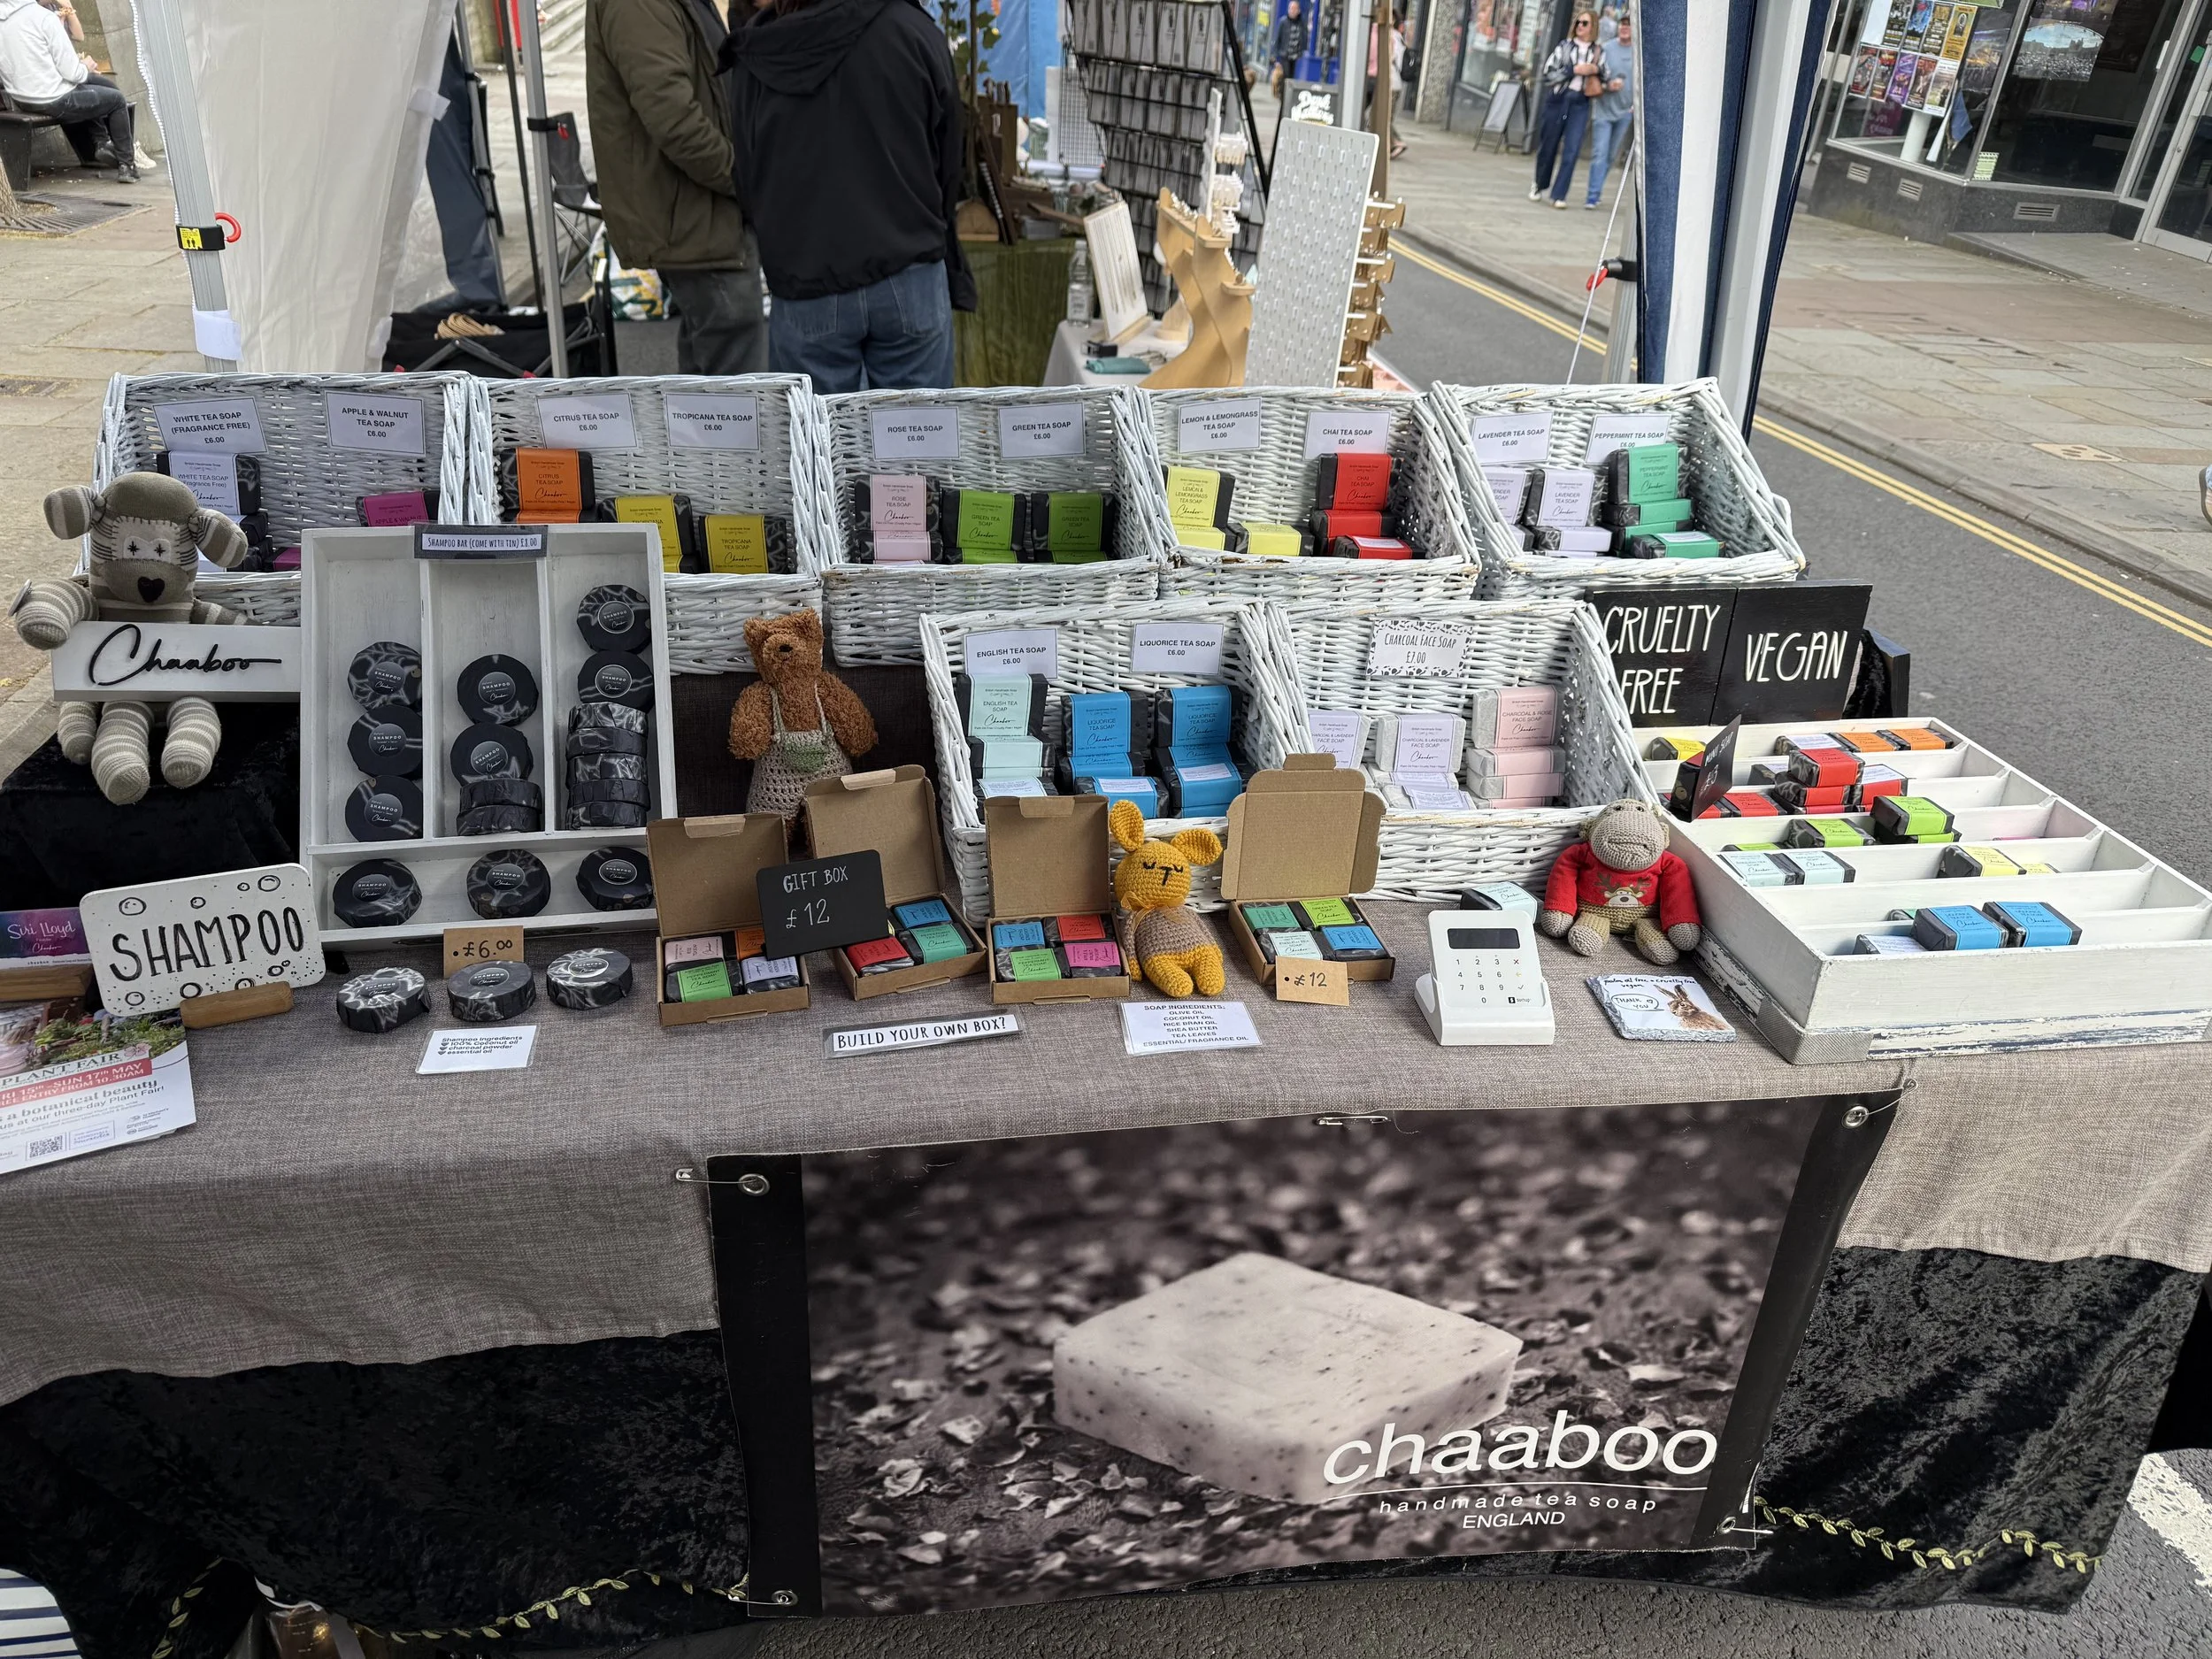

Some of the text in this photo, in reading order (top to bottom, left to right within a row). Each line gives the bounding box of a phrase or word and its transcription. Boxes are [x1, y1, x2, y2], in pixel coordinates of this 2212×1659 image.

[342, 407, 367, 416] APPLE
[375, 410, 410, 419] WALNUT
[1181, 416, 1205, 425] LEMON
[1211, 411, 1258, 420] LEMONGRASS
[172, 422, 251, 434] (FRAGRANCE FREE)
[1478, 430, 1512, 440] LAVENDER
[1602, 605, 1721, 655] CRUELTY
[89, 624, 282, 686] Chaaboo
[977, 649, 1009, 658] ENGLISH
[1406, 650, 1426, 664] £7.00
[1745, 630, 1848, 682] VEGAN
[1621, 668, 1685, 715] FREE
[370, 803, 398, 813] SHAMPOO
[783, 865, 849, 894] GIFT BOX
[7, 920, 77, 940] Siri Lloyd
[109, 905, 306, 982] SHAMPOO
[462, 939, 513, 959] £6.00
[1294, 972, 1327, 987] £12
[837, 1016, 1008, 1049] BUILD YOUR OWN BOX?
[1143, 1039, 1187, 1048] ESSENTIAL/
[1187, 1036, 1235, 1045] FRAGRANCE
[1, 1091, 17, 1102] RI
[19, 1085, 45, 1098] 15th
[85, 1070, 110, 1084] 17th
[111, 1062, 142, 1076] MAY
[2, 1064, 72, 1087] PLANT
[76, 1052, 121, 1069] FAIR
[0, 1098, 19, 1109] REE
[21, 1088, 58, 1104] ENTRY
[59, 1080, 94, 1096] FROM
[93, 1068, 144, 1088] 10.30AM
[21, 1094, 99, 1117] botanical
[103, 1079, 158, 1099] beauty
[0, 1121, 14, 1130] us
[17, 1117, 28, 1127] at
[30, 1113, 50, 1125] our
[54, 1100, 107, 1119] three-day
[109, 1093, 138, 1106] Plant
[140, 1086, 165, 1098] Fair!
[1323, 1409, 1717, 1485] chaaboo
[1379, 1493, 1657, 1514] handmade tea soap
[1462, 1511, 1566, 1530] ENGLAND
